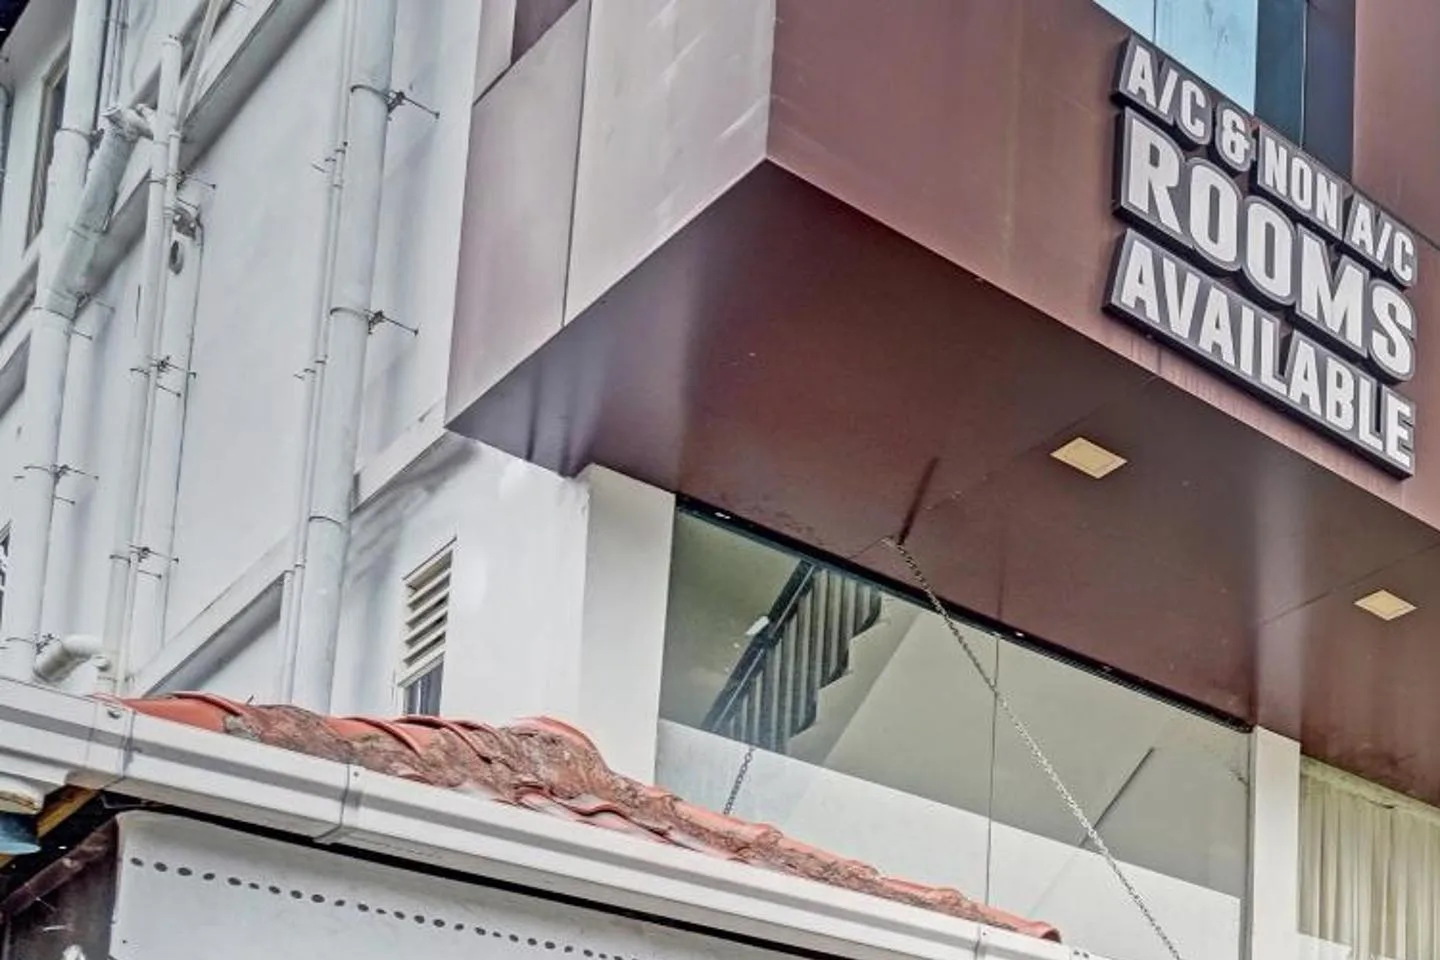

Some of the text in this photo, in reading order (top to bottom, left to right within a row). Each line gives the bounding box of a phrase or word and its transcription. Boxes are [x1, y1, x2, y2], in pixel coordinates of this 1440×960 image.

[1126, 44, 1415, 287] A/C & NON A/C
[1126, 115, 1413, 379] ROOMS
[1120, 239, 1412, 468] AVAILABLE
